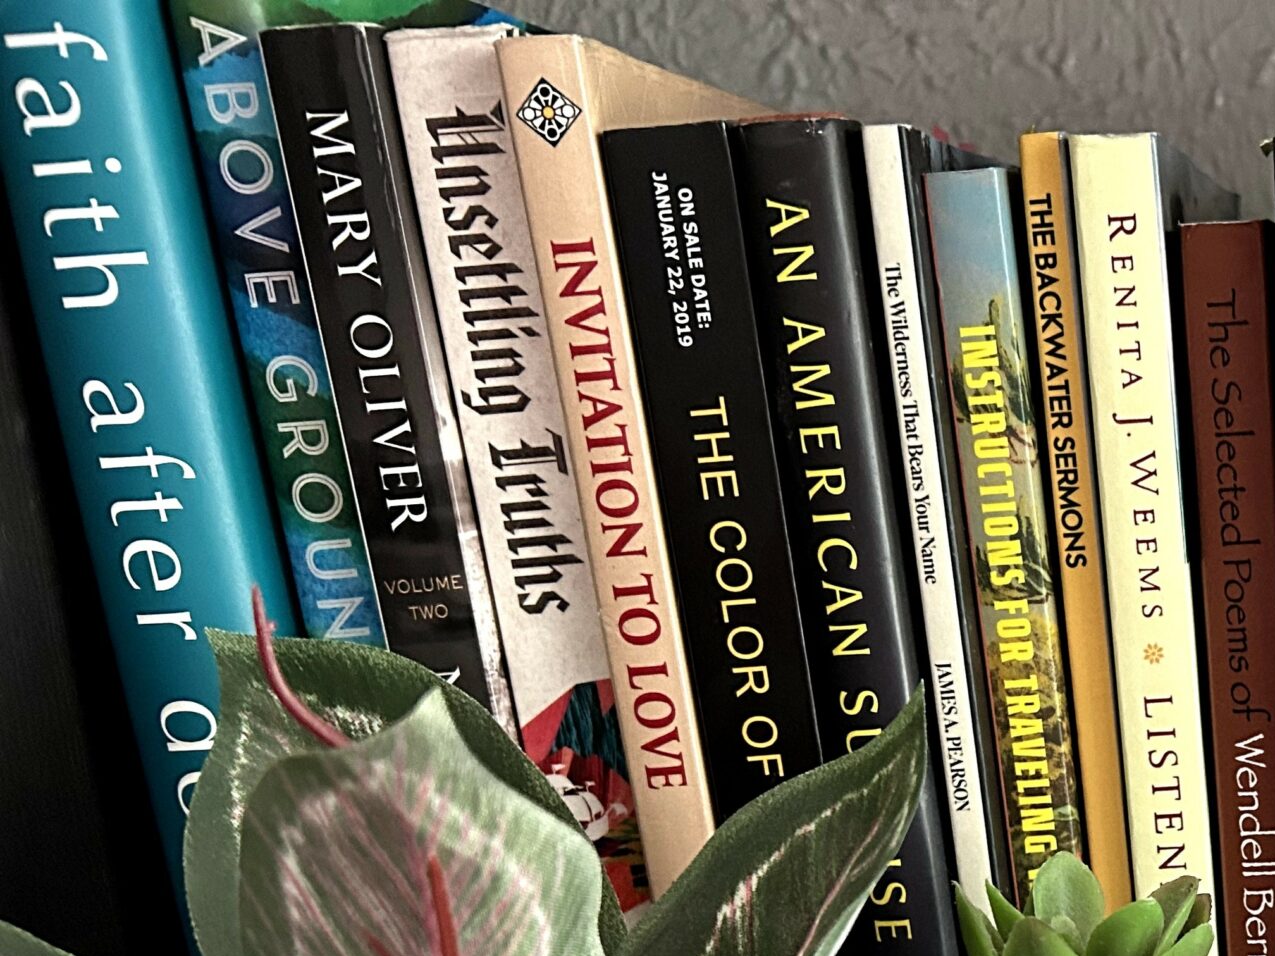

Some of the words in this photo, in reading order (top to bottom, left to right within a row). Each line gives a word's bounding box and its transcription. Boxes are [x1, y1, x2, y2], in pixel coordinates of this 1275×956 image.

[651, 171, 680, 262] JANUARY
[678, 187, 696, 220] ON
[765, 198, 818, 283] AN
[1029, 193, 1058, 249] THE
[667, 265, 688, 297] 22,
[683, 222, 705, 269] SALE
[884, 262, 901, 298] The
[4, 20, 149, 311] faith
[82, 378, 197, 641] after
[188, 15, 300, 309] ABOVE
[265, 352, 372, 640] GROUN
[304, 106, 383, 289] MARY
[348, 313, 428, 532] OLIVER
[673, 300, 694, 348] 2019
[690, 273, 712, 331] DATE:
[1034, 254, 1073, 429] BACKWATER
[1107, 212, 1143, 391] RENITA
[1207, 289, 1249, 370] The
[425, 104, 546, 416] Unsettling
[488, 426, 585, 616] Truths
[886, 303, 913, 397] Wilderness
[551, 237, 647, 558] INVITATION
[902, 400, 919, 443] That
[1112, 413, 1154, 438] J.
[690, 396, 740, 500] THE
[783, 317, 871, 657] AMERICAN
[906, 446, 925, 492] Bears
[960, 325, 1026, 588] INSTRUCTIONS
[1210, 379, 1261, 549] Selected
[911, 494, 929, 534] Your
[1053, 437, 1087, 569] SERMONS
[1129, 452, 1163, 618] WEEMS
[384, 573, 464, 597] VOLUME
[919, 537, 937, 585] Name
[408, 601, 449, 621] TWO
[611, 573, 662, 645] TO
[709, 520, 771, 698] COLOR
[995, 599, 1034, 665] FOR
[1219, 555, 1251, 674] Poems
[626, 661, 689, 791] LOVE
[934, 661, 955, 718] JAMES
[941, 720, 955, 733] A.
[1231, 681, 1272, 723] of
[741, 714, 785, 779] OF
[947, 736, 970, 813] PEARSON
[1002, 674, 1058, 854] TRAVELING
[1143, 694, 1188, 872] LISTEN
